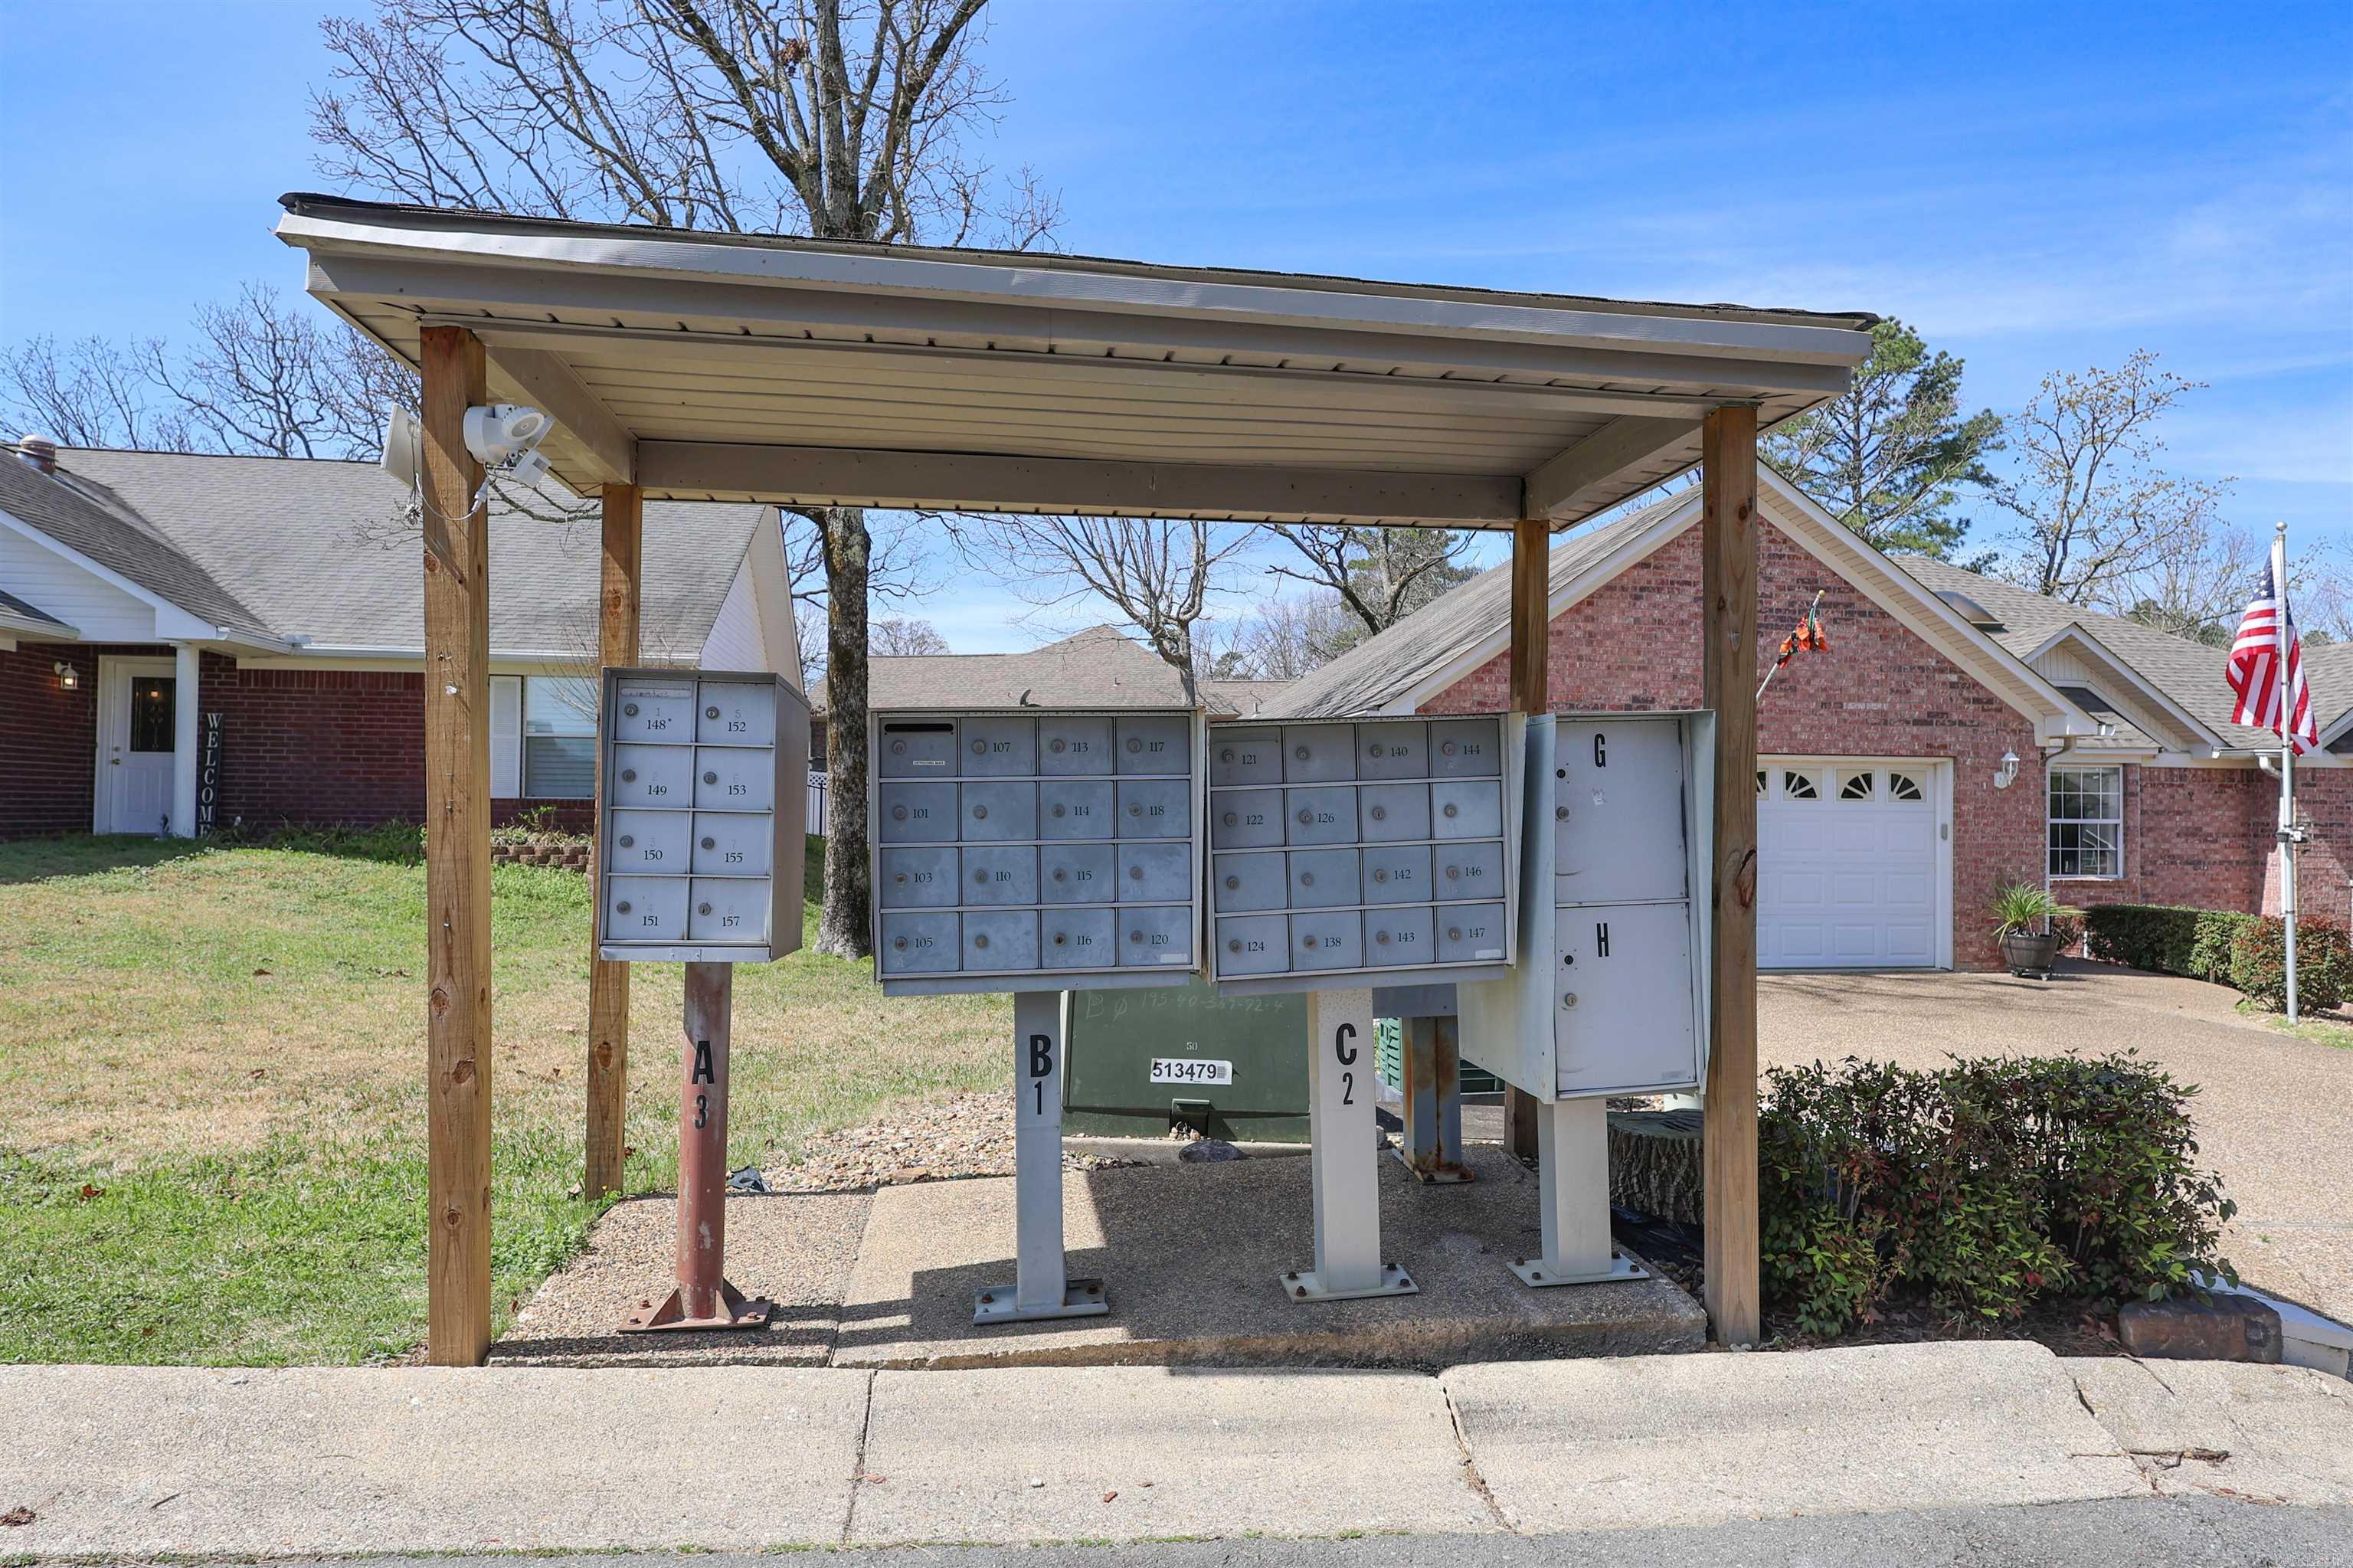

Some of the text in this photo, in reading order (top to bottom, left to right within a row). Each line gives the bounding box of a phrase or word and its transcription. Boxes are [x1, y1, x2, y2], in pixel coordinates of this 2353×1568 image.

[648, 720, 666, 729] 148
[729, 722, 745, 732] 152
[993, 742, 1010, 751] 107
[1074, 742, 1088, 752] 113
[1150, 742, 1164, 751] 117
[1464, 745, 1479, 754] 144
[1595, 734, 1605, 767] G
[1392, 747, 1407, 756] 140
[1243, 755, 1256, 764] 121
[649, 785, 666, 795] 149
[729, 785, 746, 794] 153
[914, 809, 928, 818] 101
[1075, 807, 1088, 815] 114
[1150, 807, 1164, 815] 118
[1247, 815, 1262, 824] 122
[1318, 813, 1334, 823] 126
[645, 850, 663, 859] 150
[726, 853, 742, 863] 155
[1078, 871, 1091, 880] 115
[1395, 870, 1411, 879] 142
[1466, 867, 1481, 876] 146
[915, 872, 931, 882] 103
[997, 872, 1010, 881] 110
[643, 916, 657, 925] 151
[723, 916, 739, 926] 157
[1399, 933, 1414, 941] 143
[1470, 928, 1484, 938] 147
[916, 938, 932, 948] 105
[1078, 936, 1091, 944] 116
[1152, 935, 1168, 944] 120
[1326, 938, 1341, 947] 138
[1597, 923, 1608, 957] H
[1248, 942, 1264, 951] 124
[1186, 1042, 1197, 1050] 50
[1336, 1023, 1356, 1065] C
[1030, 1035, 1052, 1077] B
[692, 1040, 715, 1084] A
[1153, 1062, 1217, 1079] 513479
[1343, 1072, 1353, 1105] 2
[1035, 1081, 1042, 1115] 1
[695, 1095, 708, 1130] 3
